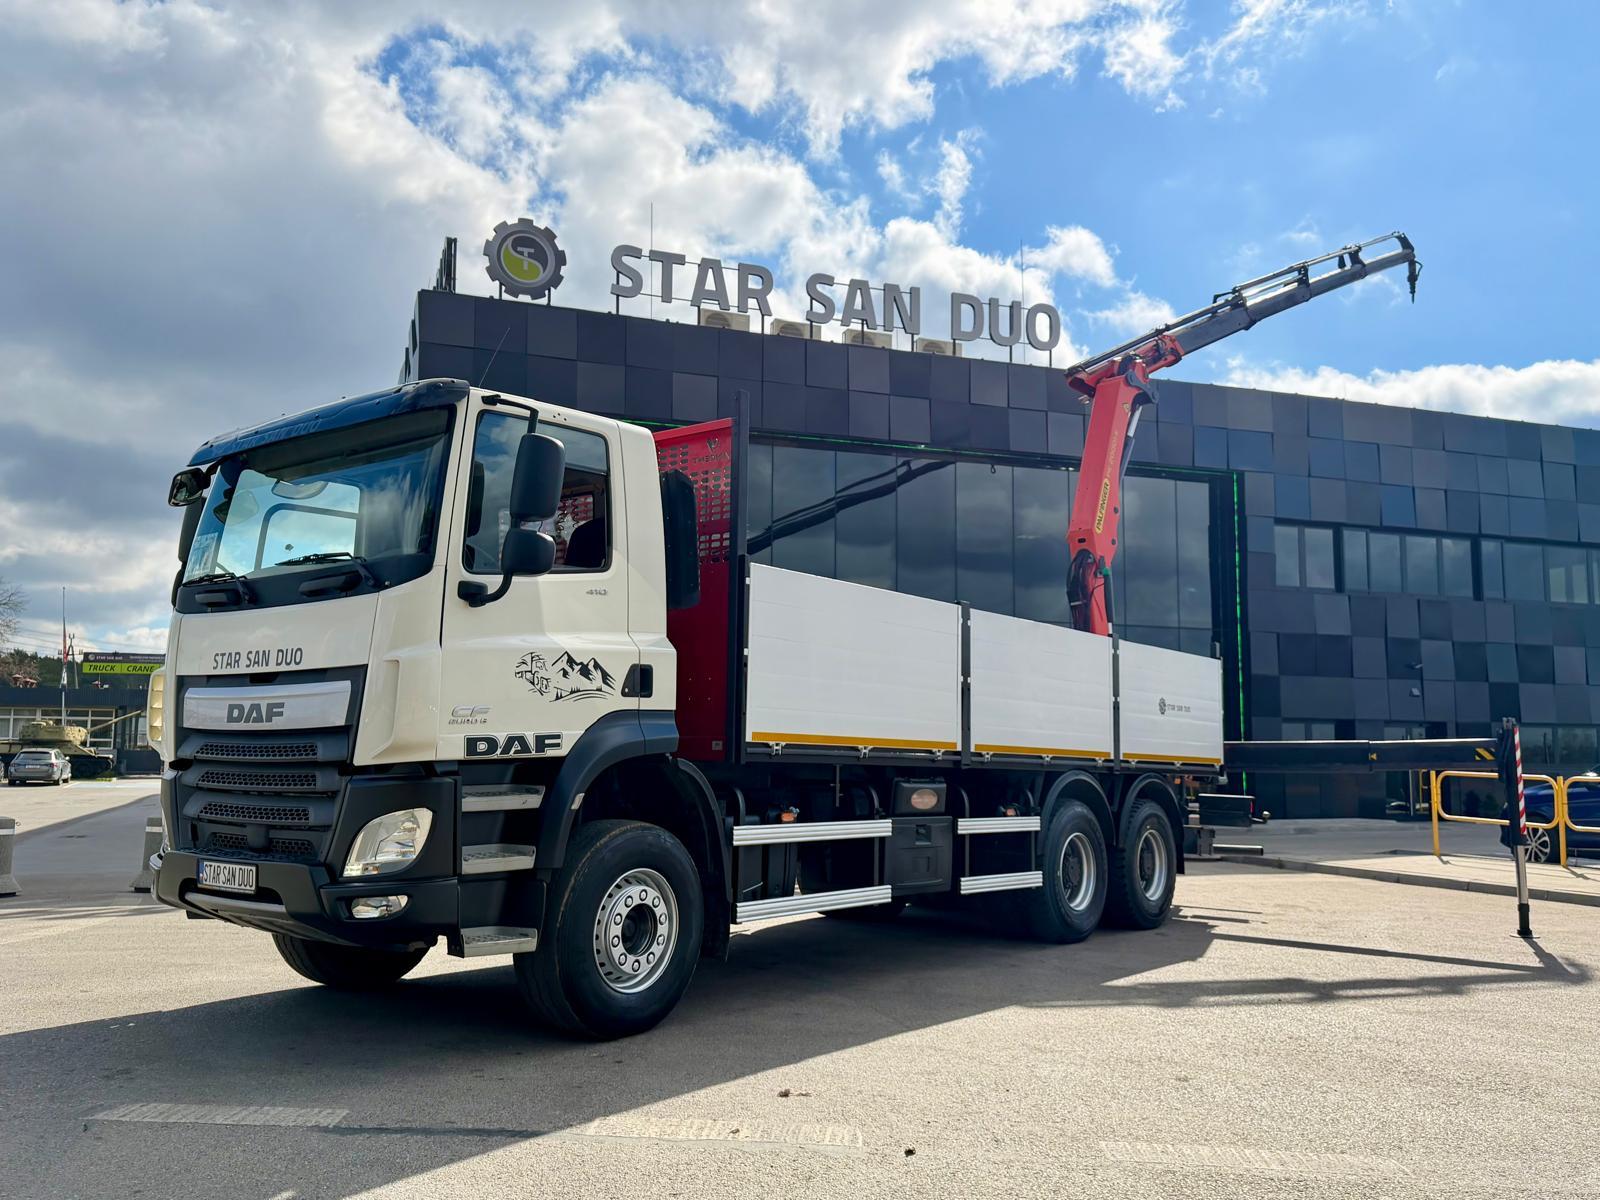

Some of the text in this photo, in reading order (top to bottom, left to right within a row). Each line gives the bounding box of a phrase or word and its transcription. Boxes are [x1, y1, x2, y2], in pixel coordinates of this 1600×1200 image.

[611, 244, 1061, 352] STAR SAN DUO
[1095, 482, 1110, 531] PALFINGER
[88, 664, 116, 672] TRUCK
[212, 647, 303, 670] STAR SAN DUO
[226, 702, 285, 724] DAF
[464, 732, 563, 760] DAF
[204, 863, 254, 888] STAR SAN DUO
